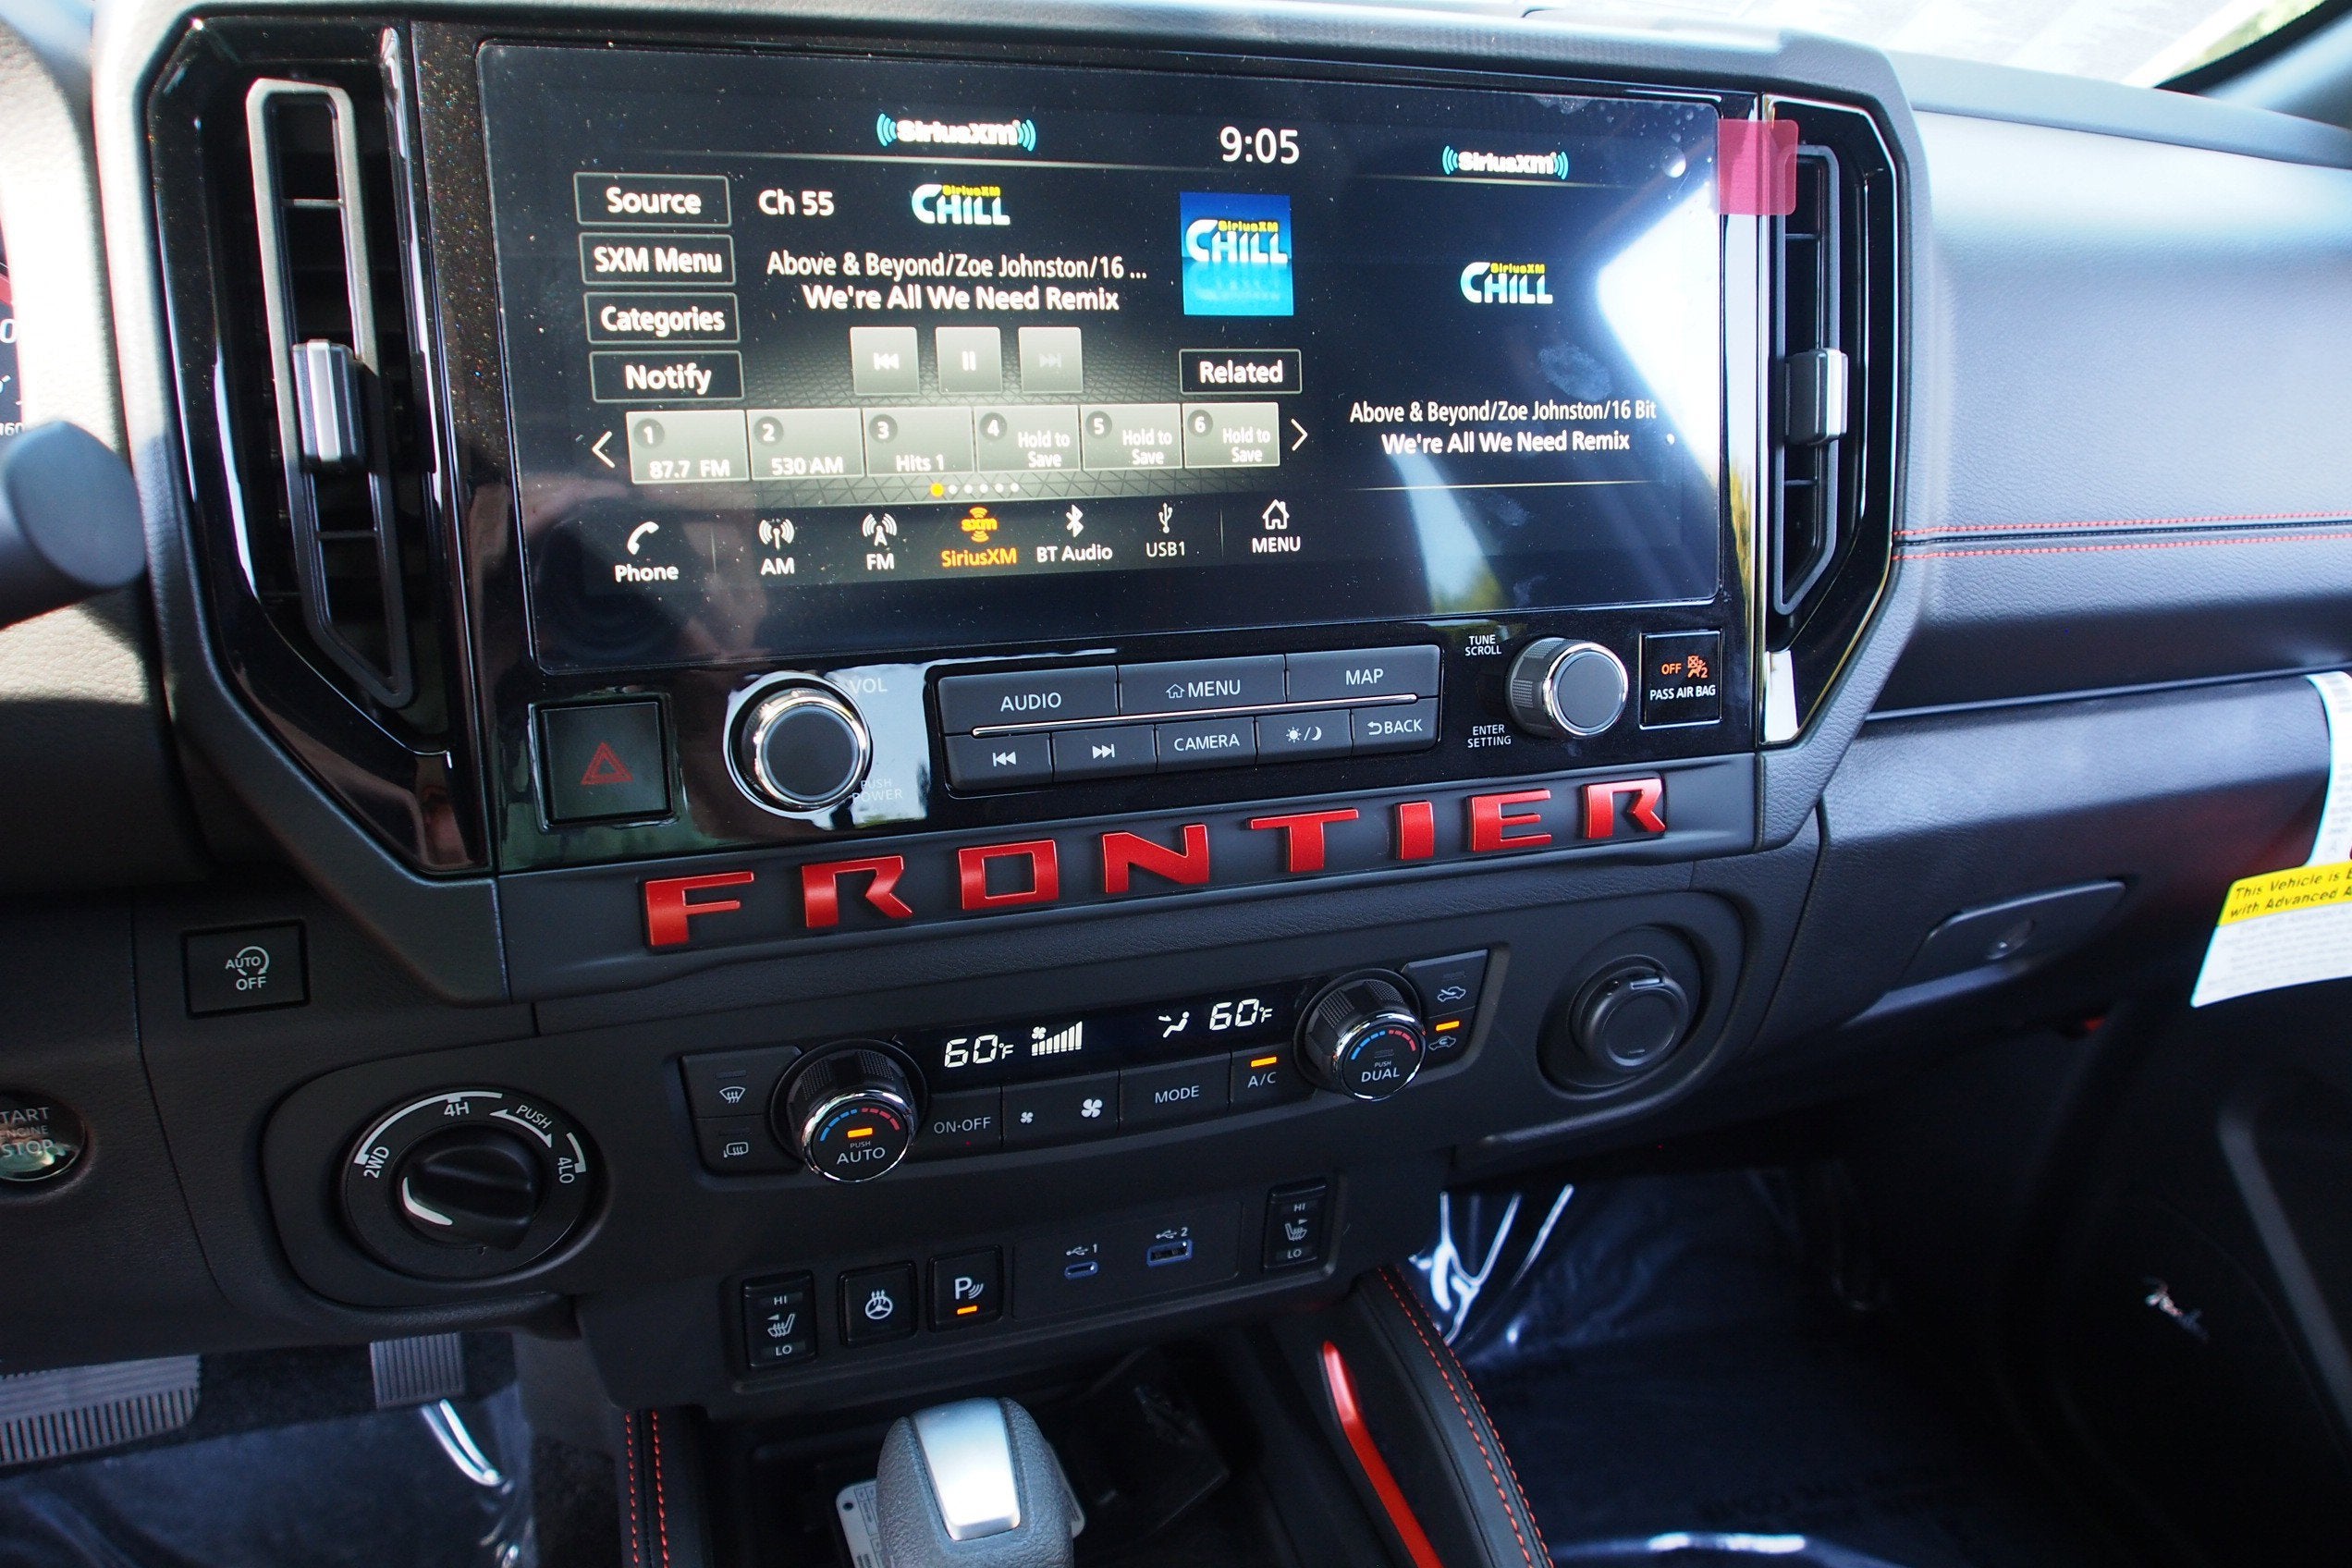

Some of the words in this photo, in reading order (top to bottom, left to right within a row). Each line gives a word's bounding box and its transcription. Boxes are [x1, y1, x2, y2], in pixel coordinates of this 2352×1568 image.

[1220, 127, 1300, 165] 9:05
[606, 187, 702, 214] Source
[758, 189, 795, 215] Ch
[802, 190, 835, 216] 55
[594, 247, 649, 274] SXM
[655, 248, 722, 273] Menu
[766, 250, 837, 276] Above
[843, 251, 860, 276] &
[865, 251, 994, 282] Beyond/Zoe
[998, 253, 1124, 279] Johnston/16
[802, 284, 881, 310] We're
[887, 283, 921, 310] All
[926, 285, 971, 311] We
[975, 285, 1039, 311] Need
[1046, 286, 1120, 311] Remix
[601, 306, 726, 337] Categories
[625, 362, 712, 396] Notify
[1199, 359, 1283, 384] Related
[1350, 401, 1405, 423] Above
[1410, 401, 1423, 422] &
[1427, 400, 1528, 426] Beyond/Zoe
[1532, 398, 1631, 422] Johnston/16
[1635, 400, 1657, 420] Bit
[763, 423, 775, 442] 2
[877, 421, 889, 440] 3
[987, 419, 1000, 437] 4
[1094, 418, 1104, 435] 5
[1194, 416, 1206, 434] 6
[644, 426, 654, 445] 1
[1018, 430, 1053, 448] Hold
[1056, 432, 1071, 447] to
[1122, 429, 1156, 447] Hold
[1158, 430, 1172, 446] to
[1222, 427, 1255, 445] Hold
[1257, 428, 1271, 444] to
[1381, 433, 1443, 455] We're
[1447, 432, 1475, 453] All
[1479, 432, 1513, 453] We
[1517, 431, 1567, 452] Need
[1572, 430, 1630, 451] Remix
[896, 453, 931, 473] Hits
[936, 454, 945, 471] 1
[1028, 451, 1062, 469] Save
[1132, 449, 1164, 466] Save
[1231, 447, 1263, 463] Save
[649, 460, 691, 478] 87.7
[700, 459, 730, 477] FM
[771, 457, 806, 476] 530
[809, 456, 844, 475] AM
[1036, 545, 1061, 563] BT
[1062, 544, 1113, 562] Audio
[1145, 540, 1185, 557] USB1
[1252, 536, 1301, 554] MENU
[760, 557, 795, 576] AM
[866, 553, 895, 570] FM
[941, 547, 1017, 568] SiriusXM
[615, 563, 680, 582] Phone
[1468, 634, 1496, 646] TUNE
[1464, 644, 1502, 656] SCROLL
[1345, 668, 1384, 686] MAP
[1661, 664, 1682, 676] OFF
[849, 678, 888, 694] VOL
[1187, 680, 1242, 698] MENU
[1649, 688, 1674, 701] PASS
[1676, 686, 1694, 699] AIR
[1696, 685, 1716, 697] BAG
[1000, 692, 1062, 712] AUDIO
[1385, 719, 1423, 735] BACK
[1473, 724, 1505, 737] ENTER
[1174, 734, 1241, 753] CAMERA
[1467, 735, 1512, 749] SETTING
[860, 778, 893, 790] PUSH
[851, 789, 903, 804] POWER
[644, 777, 1667, 947] FRONTIER
[2236, 887, 2264, 900] This
[2270, 874, 2323, 893] Vehicle
[2328, 872, 2340, 883] is
[2230, 903, 2260, 919] with
[2264, 888, 2339, 912] Advanced
[225, 956, 262, 970] AUTO
[236, 976, 267, 991] OFF
[1247, 1071, 1277, 1089] A/C
[1361, 1067, 1401, 1083] DUAL
[1155, 1084, 1200, 1104] MODE
[0, 1107, 49, 1125] TART
[444, 1101, 470, 1117] 4H
[516, 1104, 553, 1130] PUSH
[2, 1139, 54, 1158] STOP
[850, 1140, 871, 1149] PUSH
[362, 1145, 390, 1179] 2WD
[836, 1146, 886, 1165] AUTO
[557, 1156, 575, 1184] 4LO
[1293, 1203, 1306, 1212] HI
[1181, 1227, 1189, 1237] 2
[1287, 1249, 1303, 1259] LO
[774, 1295, 788, 1306] HI
[776, 1345, 792, 1356] LO
